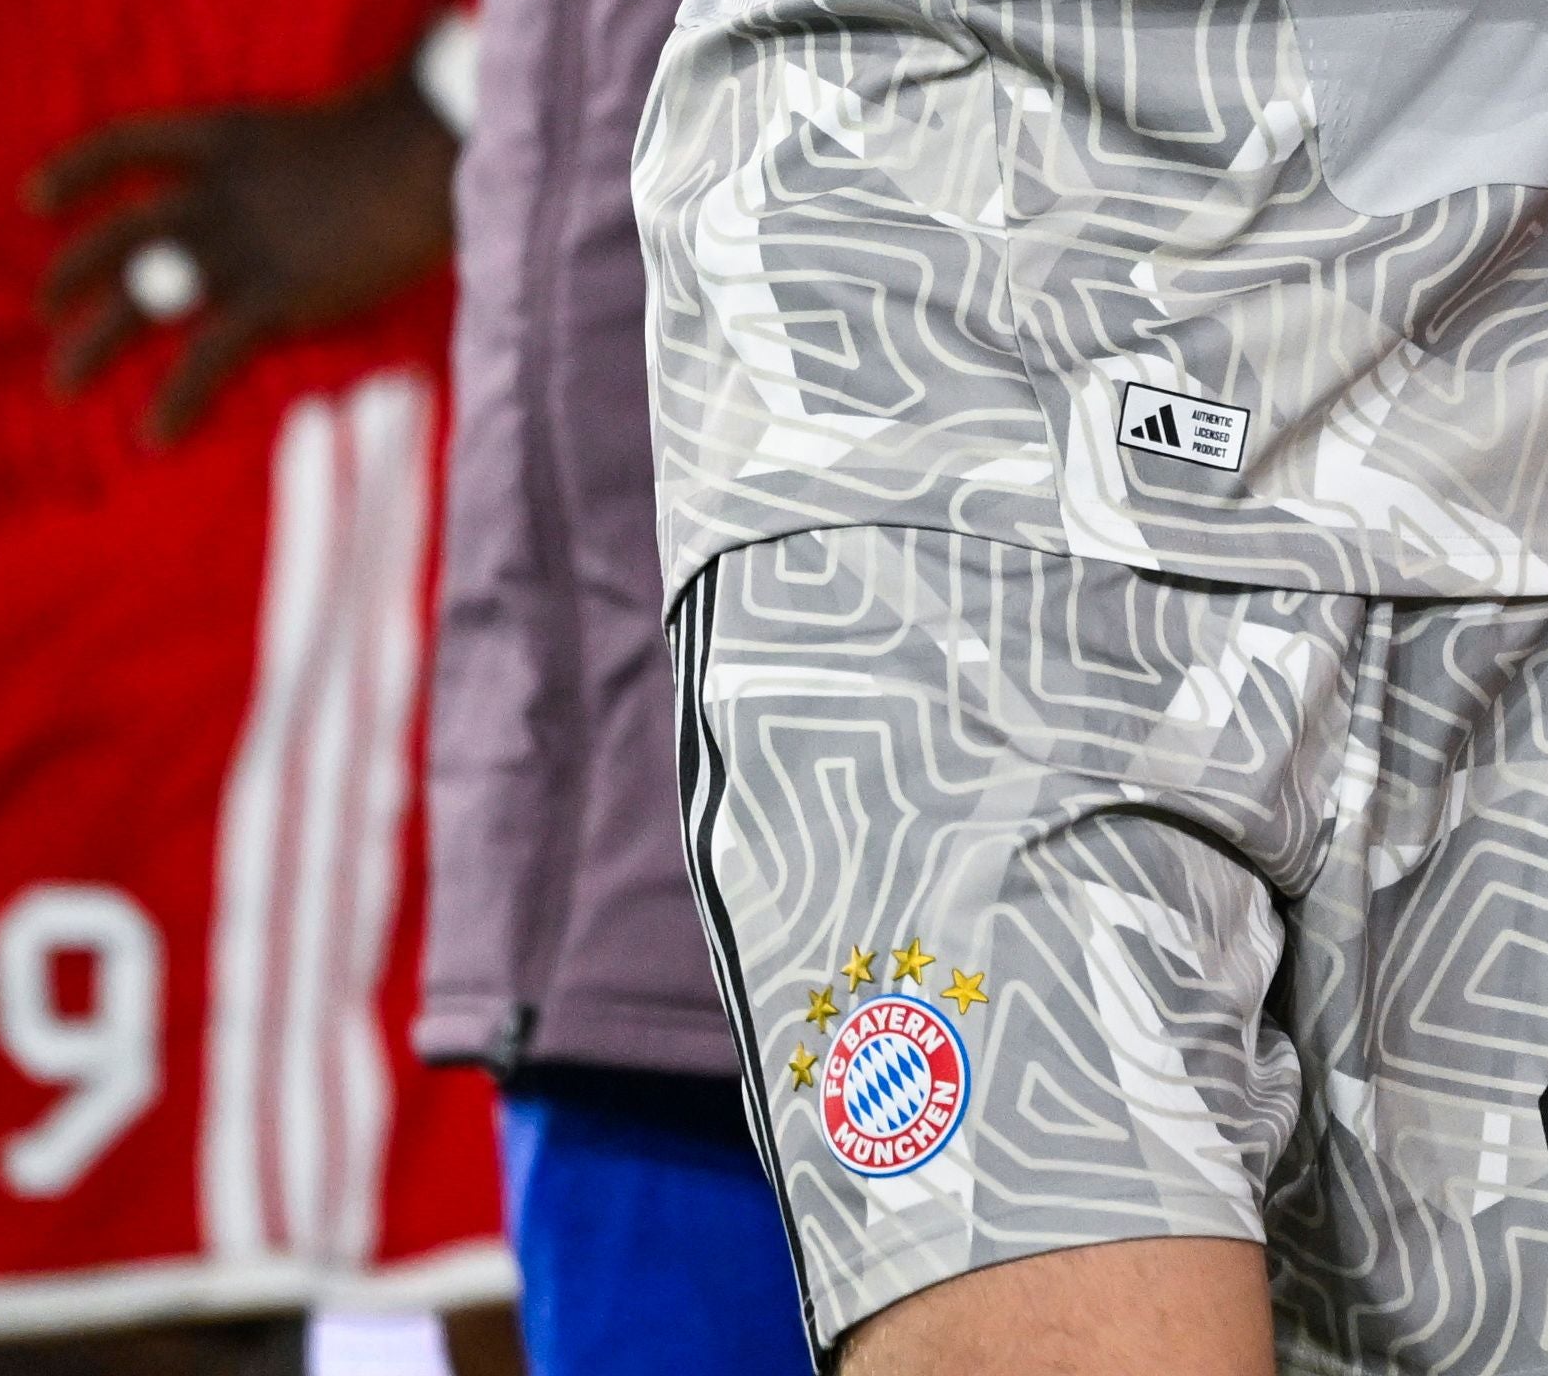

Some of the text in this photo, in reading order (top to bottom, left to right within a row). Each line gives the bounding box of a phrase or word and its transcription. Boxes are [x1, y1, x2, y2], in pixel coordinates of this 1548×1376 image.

[1192, 410, 1233, 427] AUTHENTIC
[1194, 426, 1230, 443] LICENSED
[1192, 442, 1227, 458] PRODUCT
[825, 1005, 946, 1098] FC BAYERN
[834, 1079, 958, 1166] MÜNCHEN
